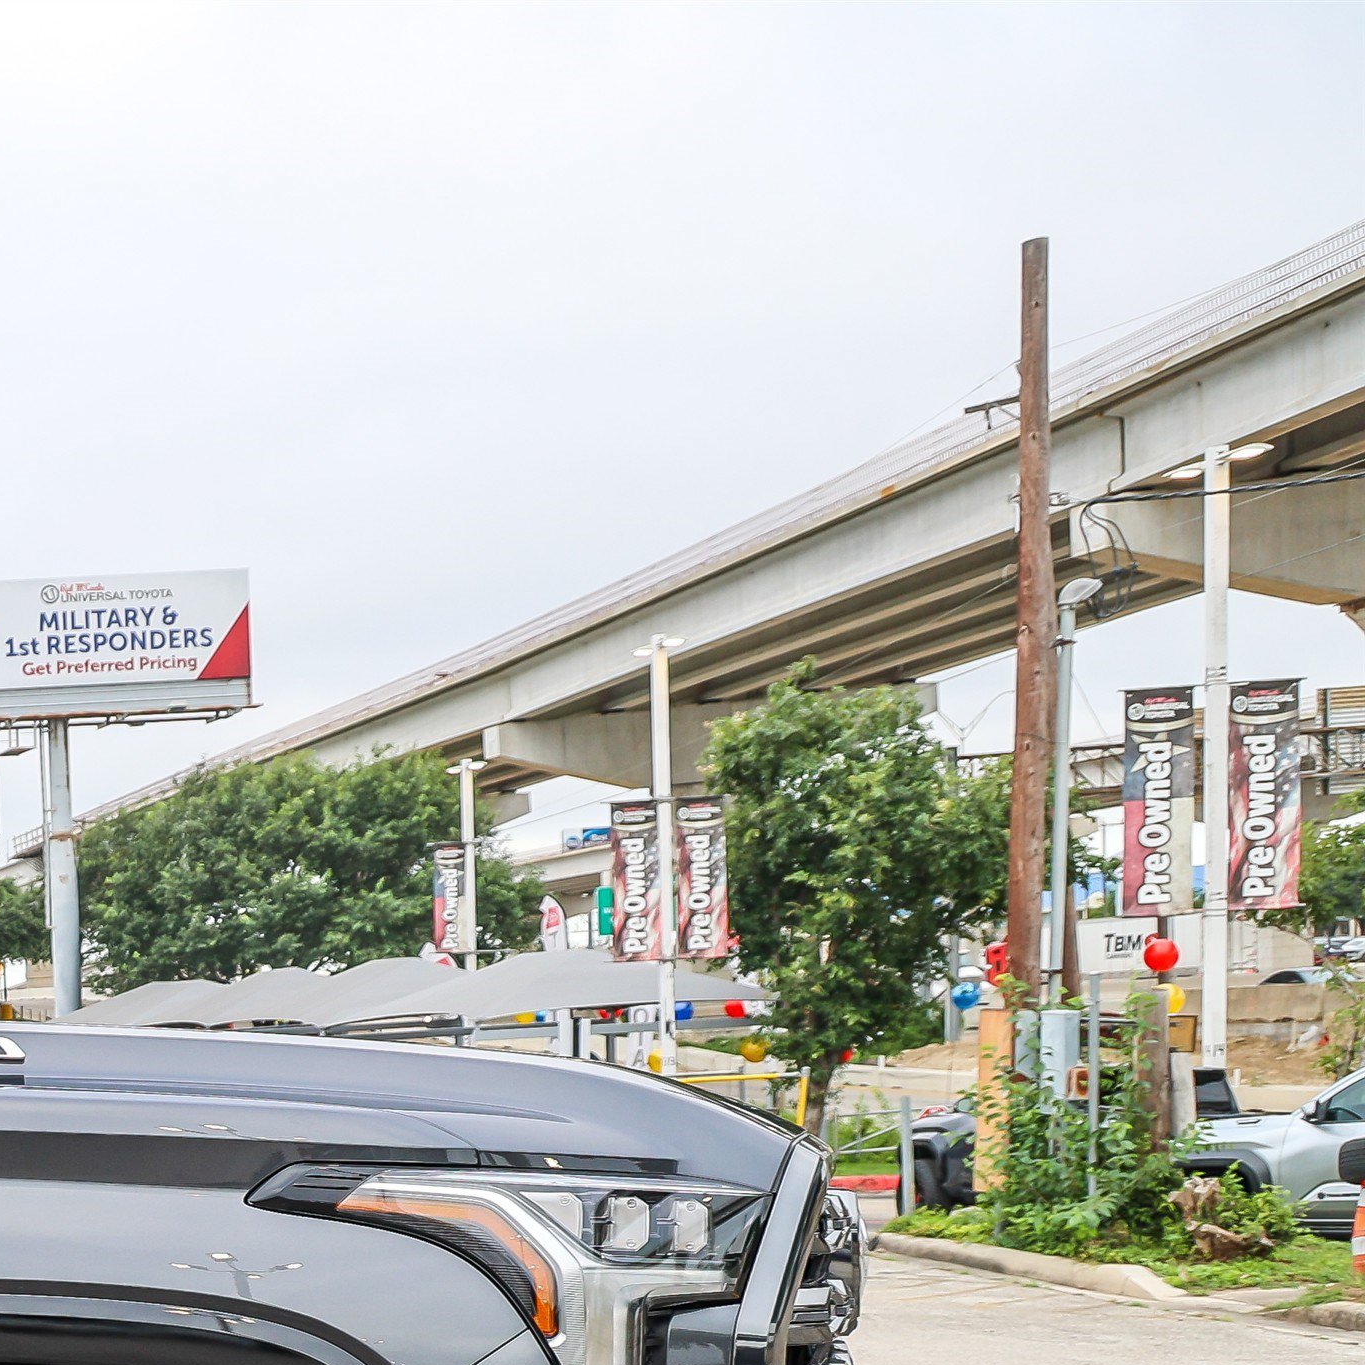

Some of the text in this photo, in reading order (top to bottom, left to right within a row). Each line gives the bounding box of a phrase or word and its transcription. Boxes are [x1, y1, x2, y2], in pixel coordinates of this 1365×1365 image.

[61, 589, 173, 602] UNIVERSAL TOYOTA
[39, 605, 178, 632] MILITARY &
[5, 626, 214, 657] 1st RESPONDERS
[22, 655, 198, 676] Get Preferred Pricing
[1138, 741, 1172, 848] Owned
[1242, 734, 1276, 841] Owned
[622, 837, 647, 914] Owned
[685, 834, 711, 911] Owned
[1136, 852, 1172, 905] Pre
[1241, 846, 1276, 898] Pre
[623, 916, 648, 953] Pre
[687, 913, 712, 950] Pre
[1105, 933, 1143, 952] TBM
